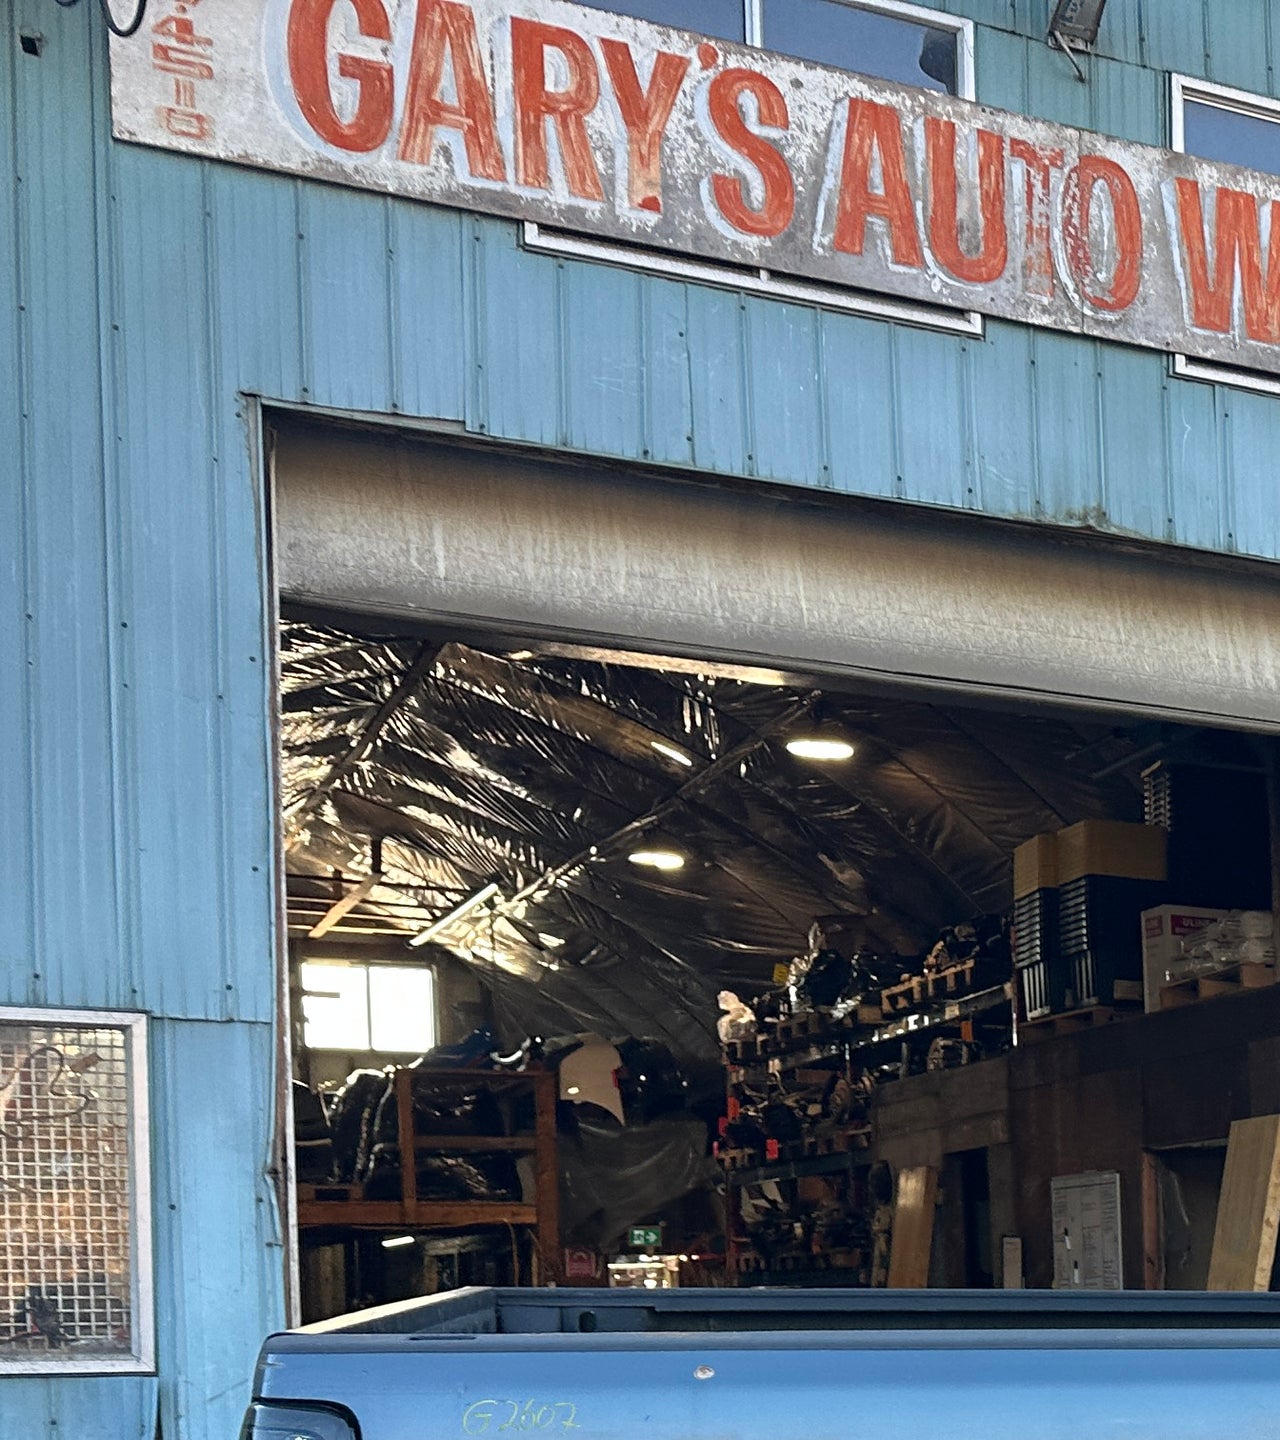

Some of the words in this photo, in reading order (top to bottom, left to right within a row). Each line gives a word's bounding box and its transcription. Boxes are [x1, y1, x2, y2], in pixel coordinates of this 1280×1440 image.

[283, 0, 797, 237] GARY'S
[834, 96, 1142, 311] AUTO
[462, 1399, 582, 1436] G2607
